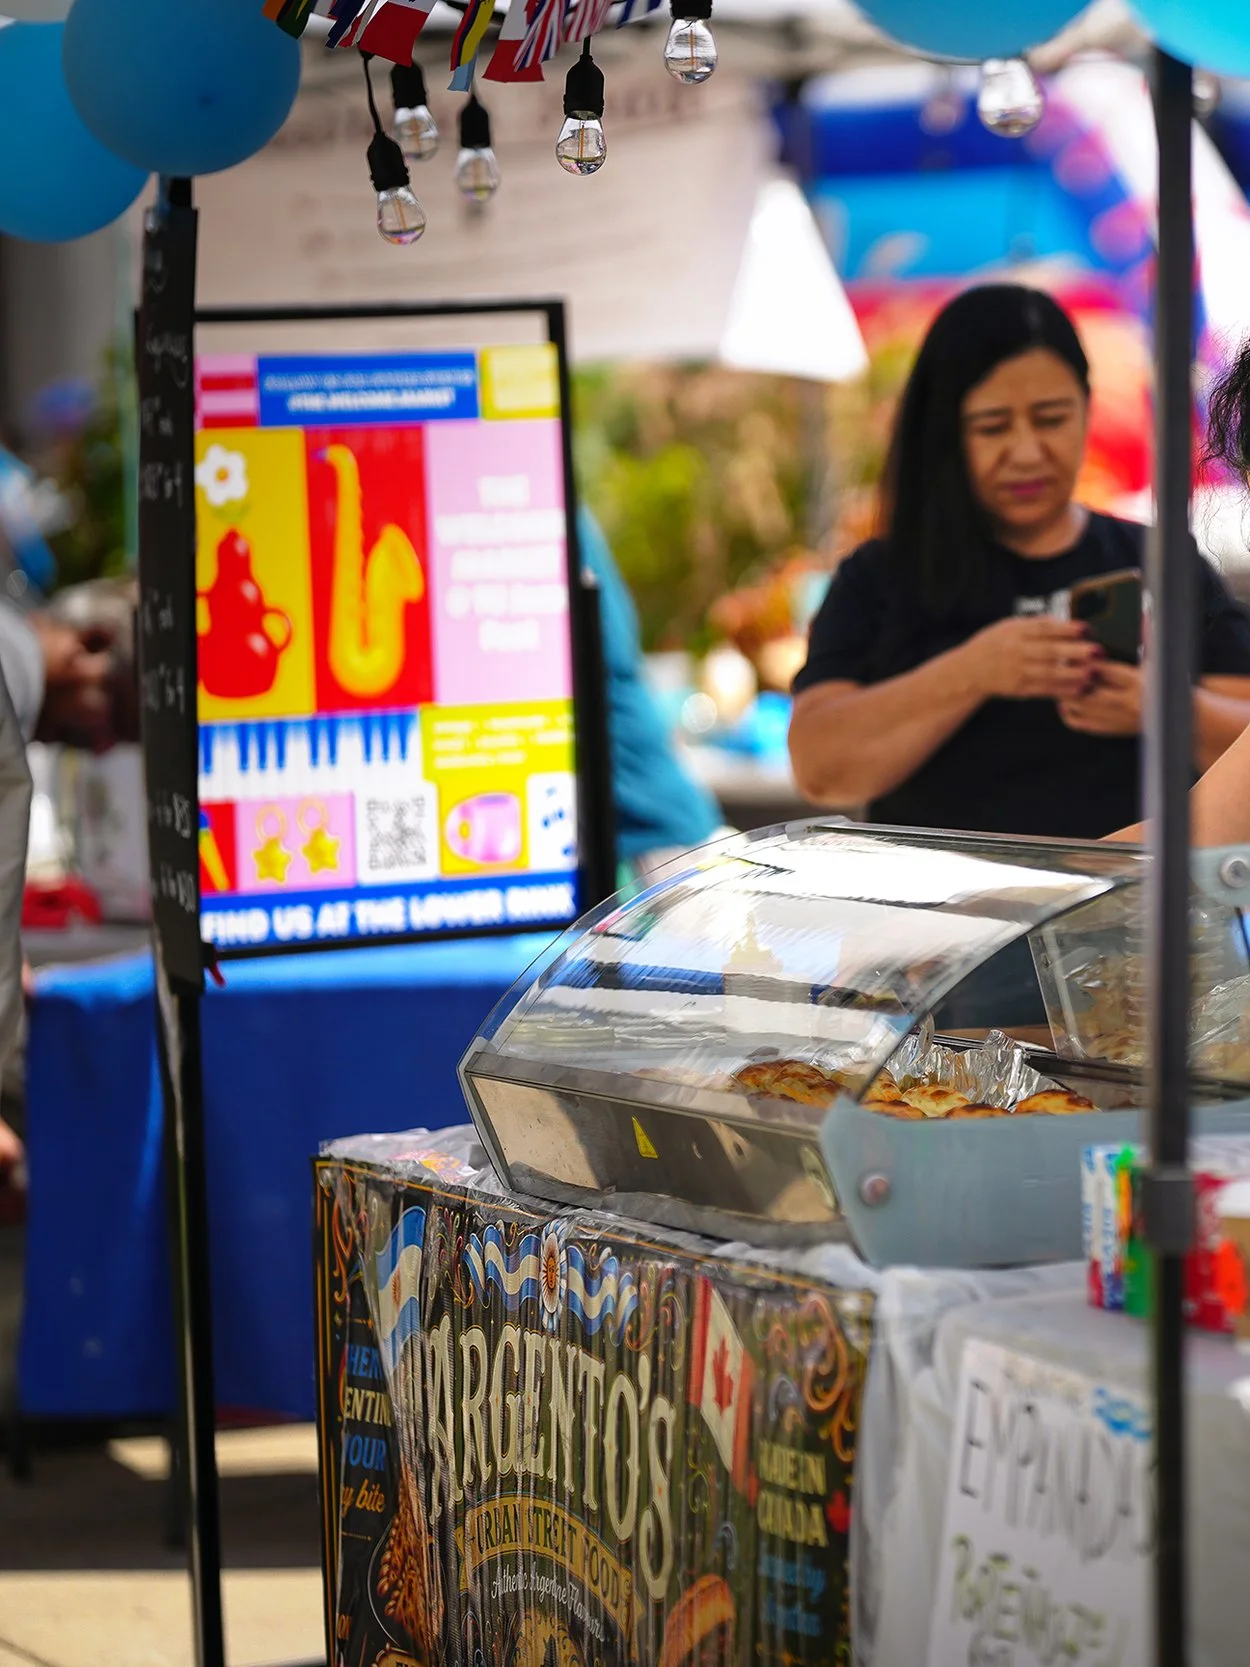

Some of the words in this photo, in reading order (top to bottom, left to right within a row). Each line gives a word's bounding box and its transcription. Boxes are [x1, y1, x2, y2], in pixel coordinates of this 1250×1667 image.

[201, 908, 269, 945] FIND
[272, 904, 313, 941] US
[316, 901, 351, 938] AT
[353, 896, 406, 935] THE
[409, 888, 504, 930] LOWER
[428, 1313, 676, 1600] ARGENTO'S
[355, 1478, 385, 1512] bite
